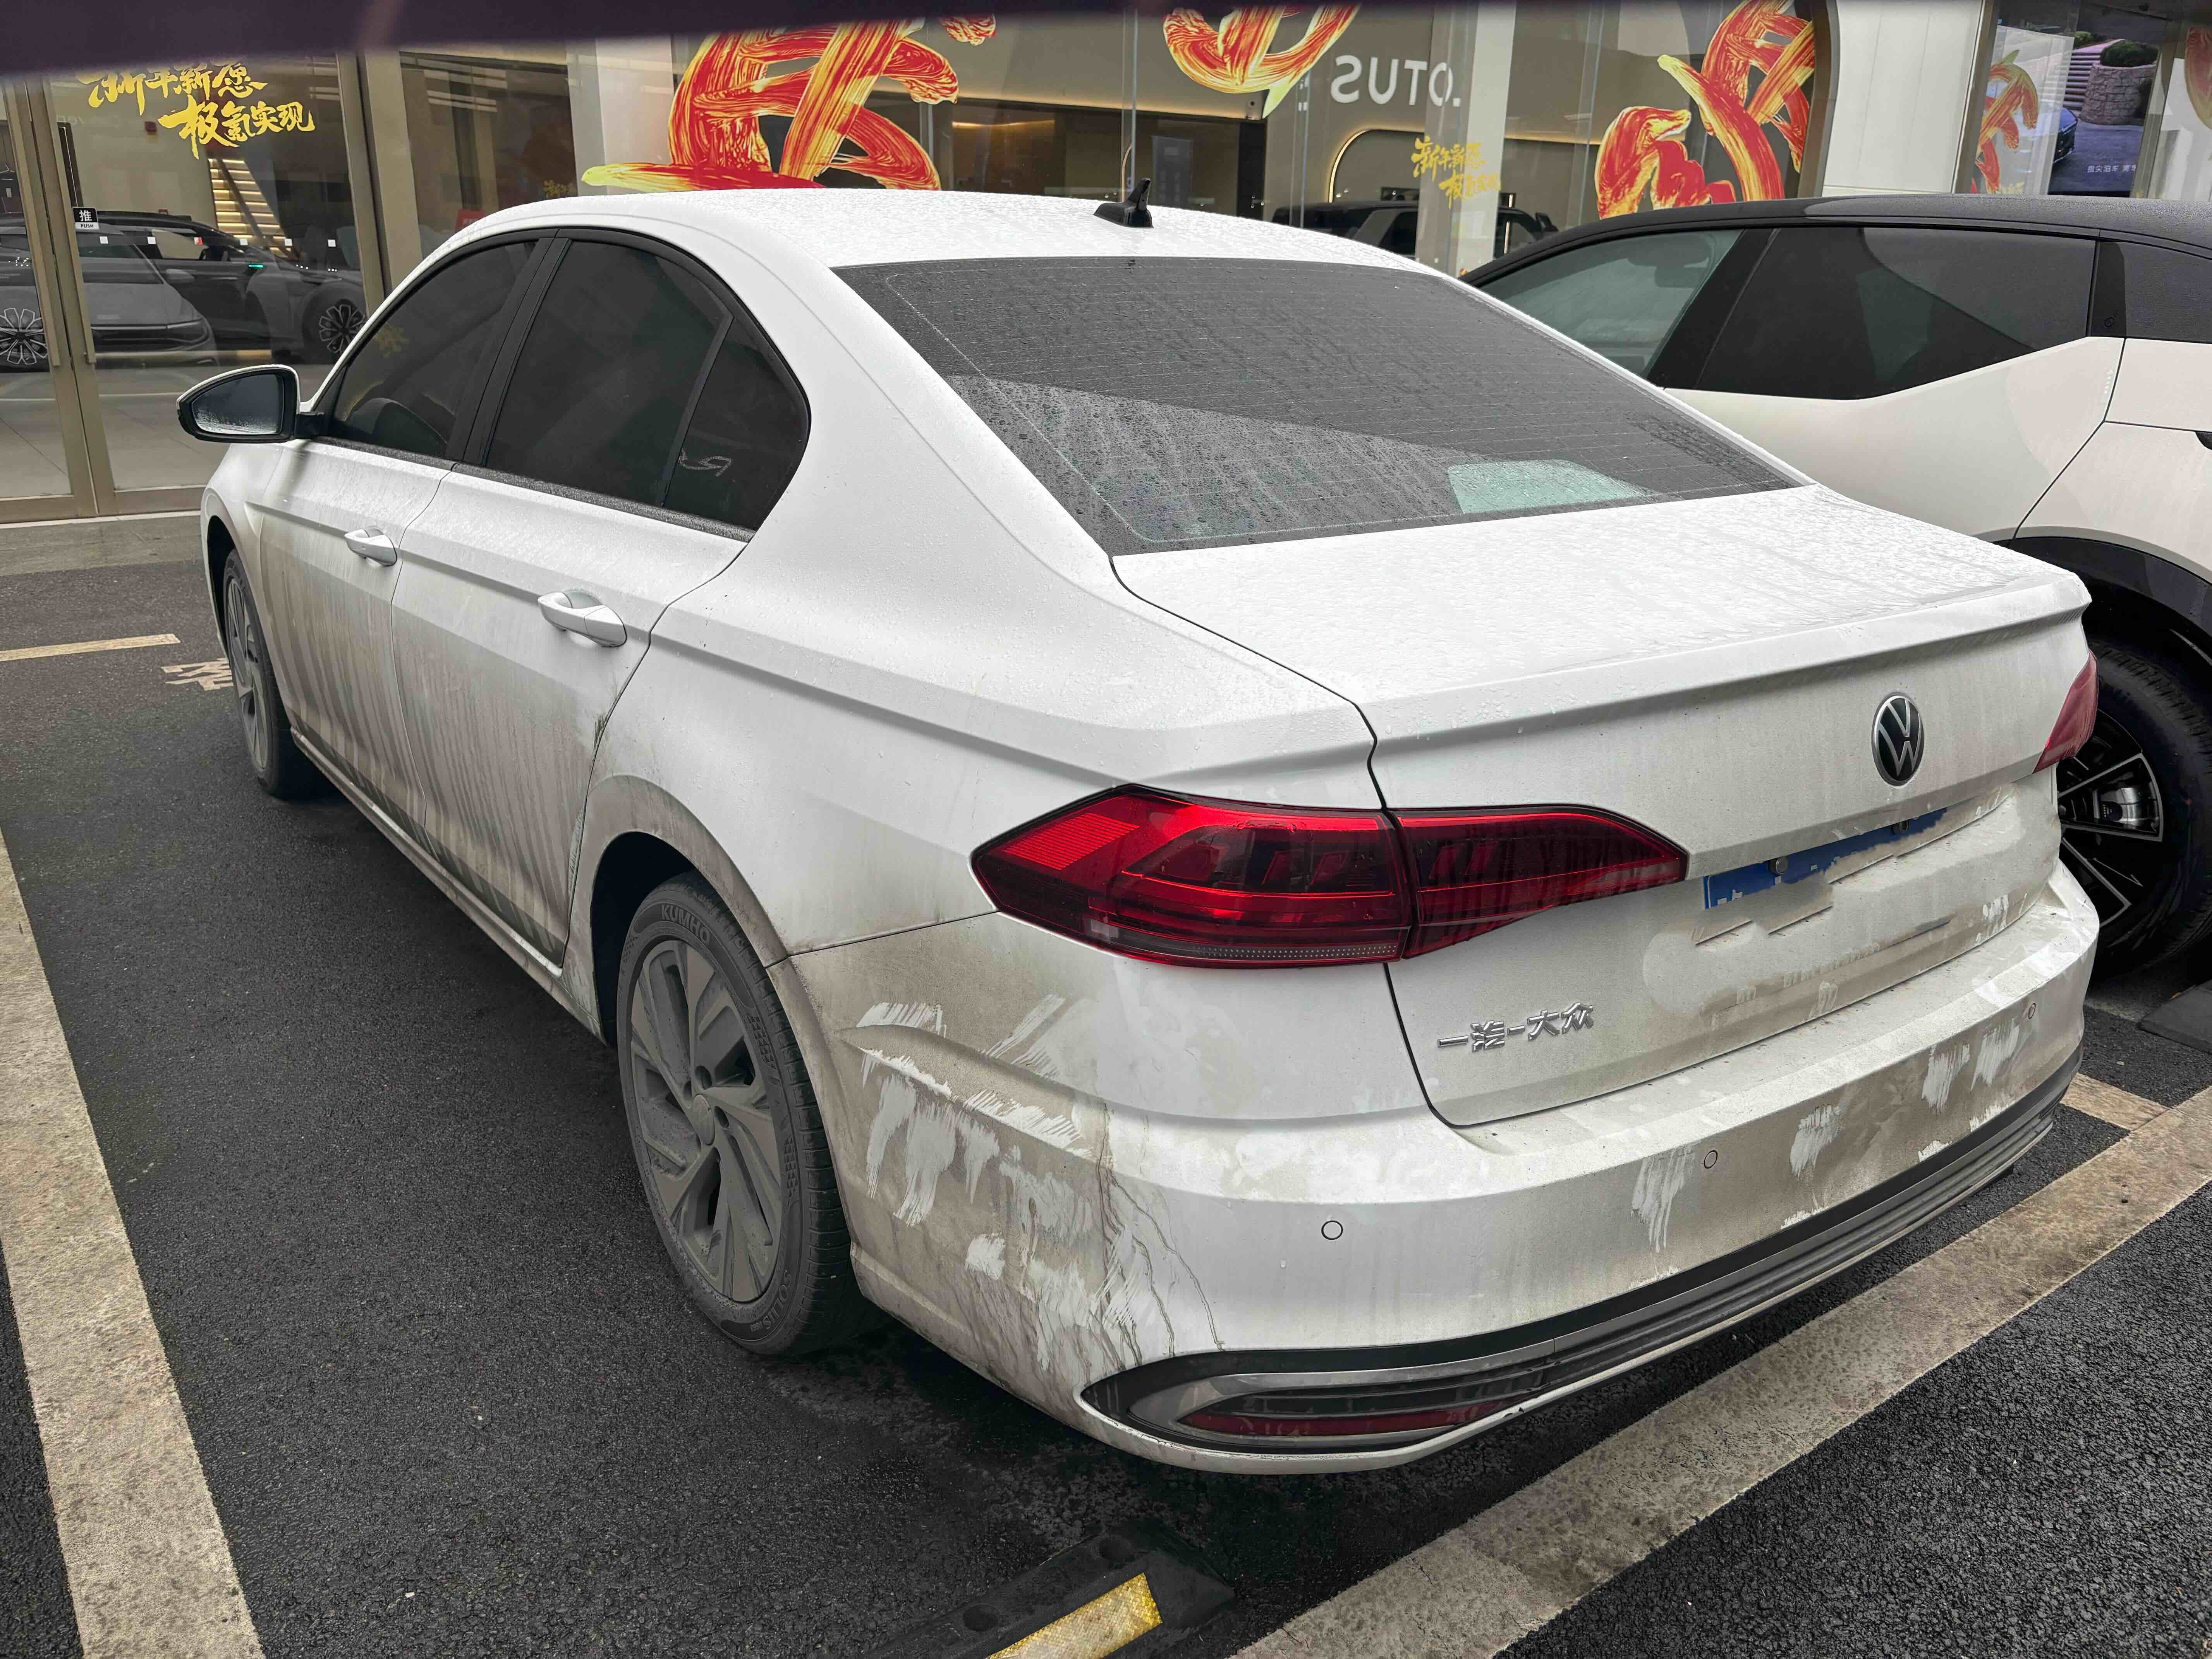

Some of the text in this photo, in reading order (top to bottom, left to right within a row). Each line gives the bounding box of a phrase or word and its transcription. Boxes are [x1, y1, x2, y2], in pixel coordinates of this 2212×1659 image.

[158, 94, 316, 160] 极氪实现
[79, 210, 92, 221] 推
[661, 904, 710, 944] KUMHO
[1437, 1001, 1594, 1053] 一汽-大众
